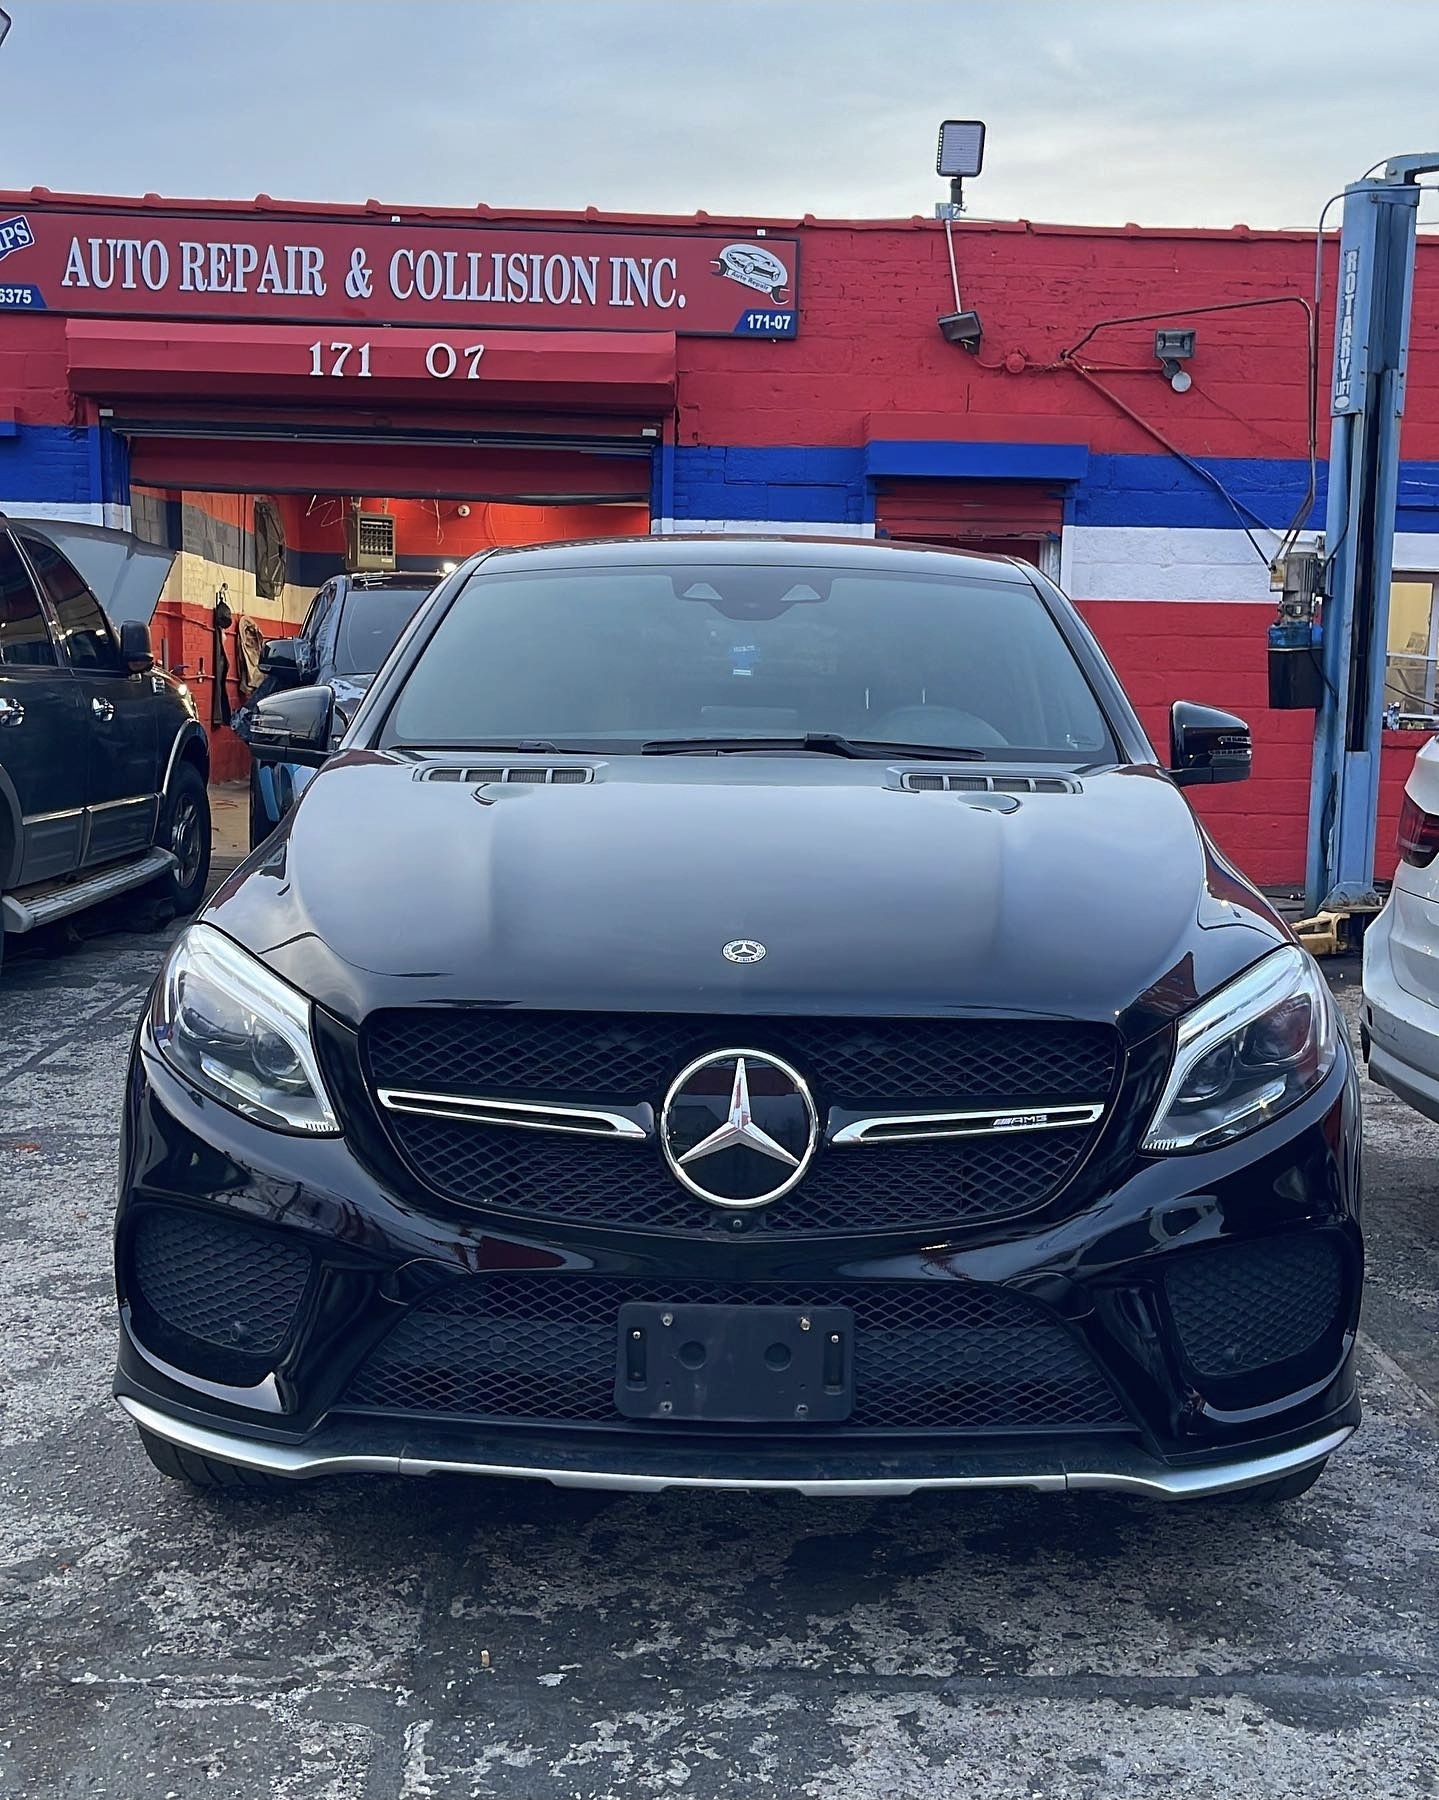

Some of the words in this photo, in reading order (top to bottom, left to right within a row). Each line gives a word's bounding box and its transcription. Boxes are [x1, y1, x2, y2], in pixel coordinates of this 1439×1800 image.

[61, 236, 169, 291] AUTO
[179, 241, 327, 297] REPAIR
[345, 247, 373, 298] &
[389, 248, 600, 305] COLLISION
[608, 257, 686, 308] INC.
[731, 271, 746, 281] Auto
[747, 277, 769, 290] Repair
[747, 314, 791, 330] 171-07
[1339, 250, 1357, 379] ROTARY
[309, 340, 372, 377] 171
[1335, 381, 1351, 396] LIFT
[1011, 1114, 1048, 1125] AMG
